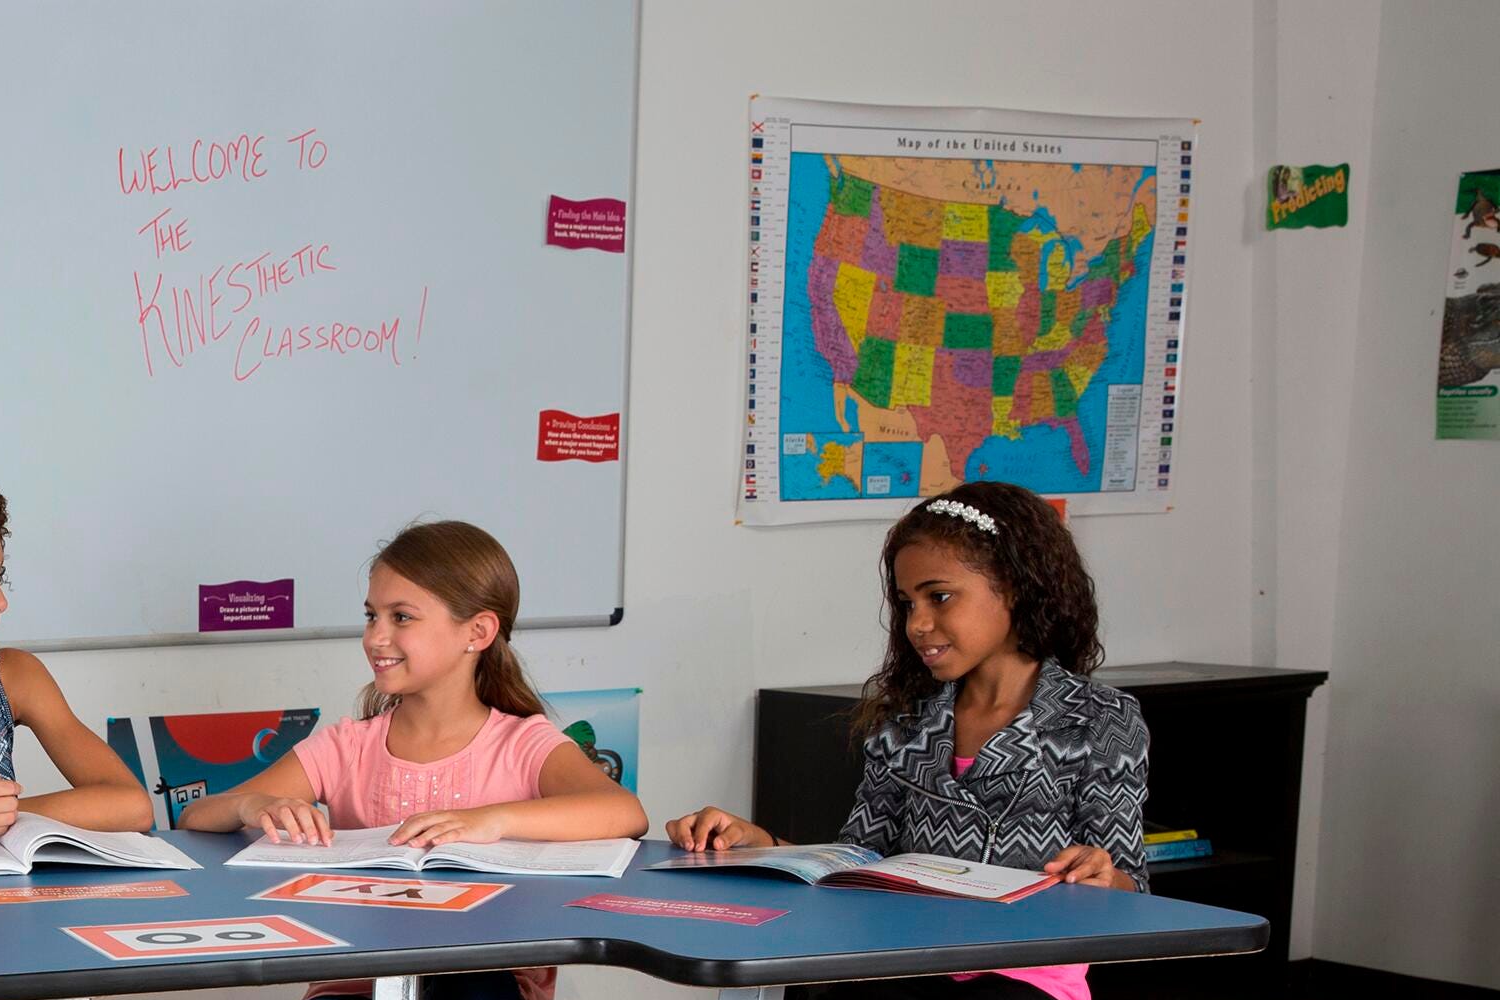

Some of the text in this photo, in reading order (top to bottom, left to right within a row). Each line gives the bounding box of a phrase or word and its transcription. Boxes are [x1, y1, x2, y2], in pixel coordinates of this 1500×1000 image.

[118, 128, 328, 194] WELCOME TO
[897, 137, 1062, 154] Map of the United States
[1271, 168, 1345, 224] Predicting
[138, 207, 192, 259] THE
[133, 244, 338, 377] KINESTHETIC
